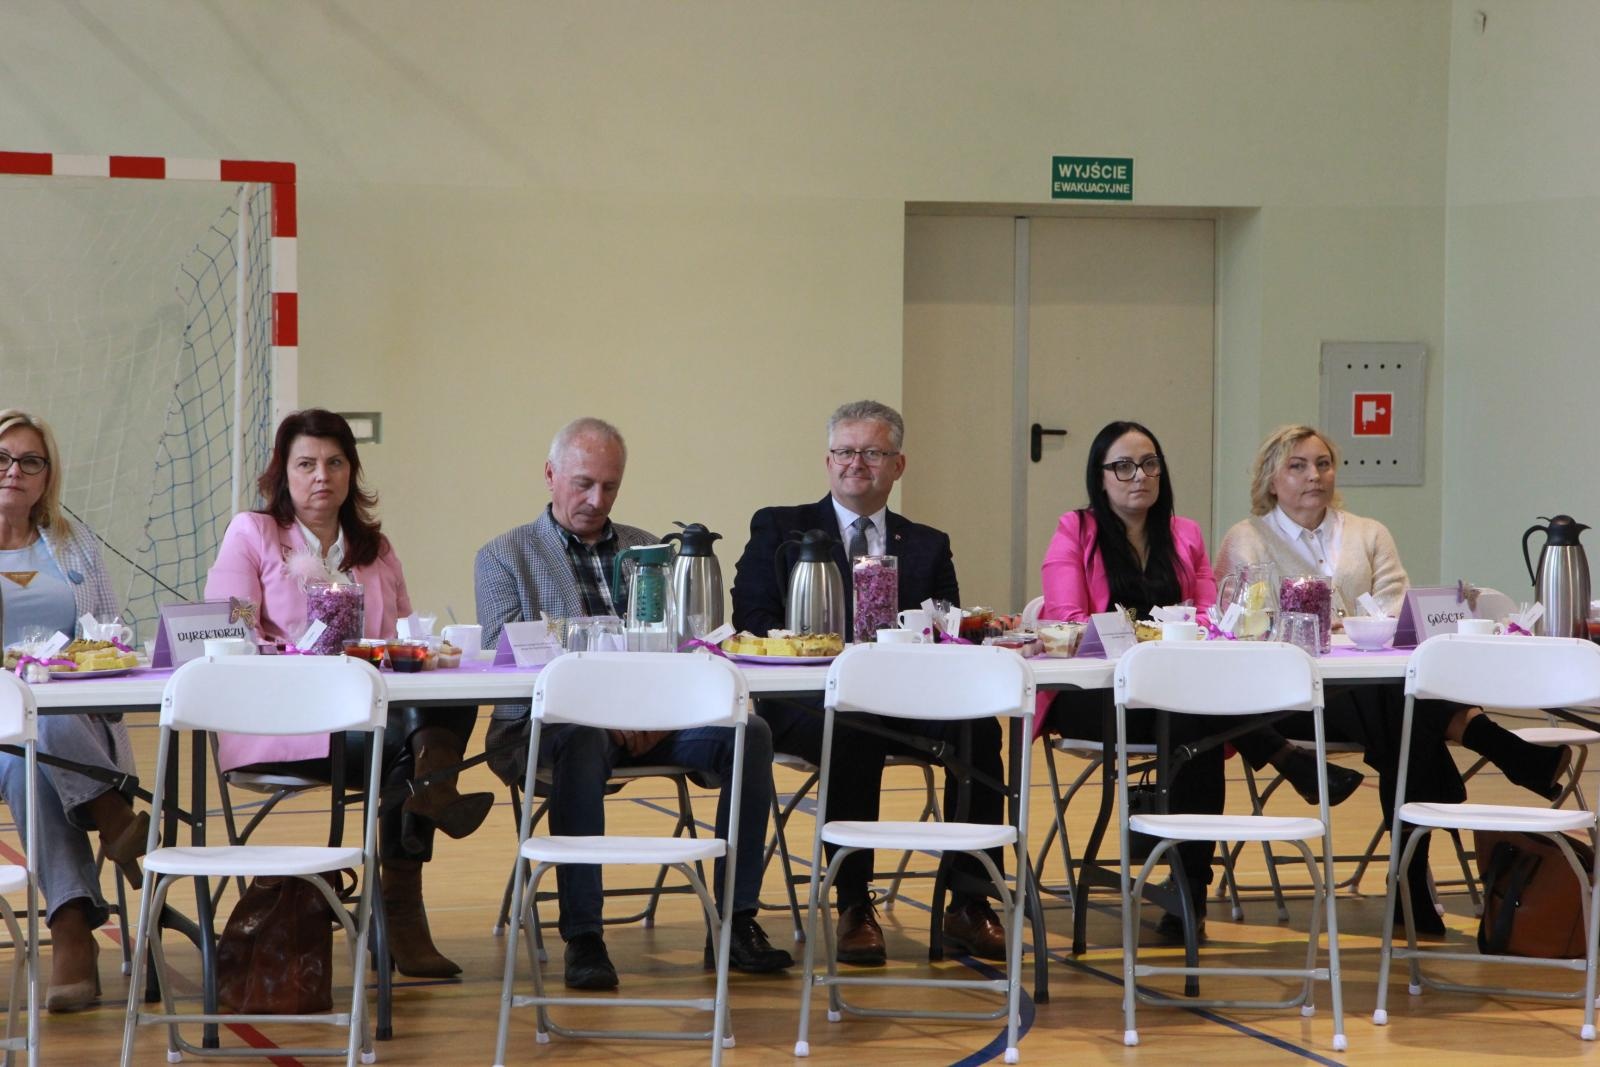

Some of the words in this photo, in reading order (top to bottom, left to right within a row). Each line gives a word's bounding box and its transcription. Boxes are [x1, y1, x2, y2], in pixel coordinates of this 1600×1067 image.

[1058, 161, 1127, 179] WYJŚCIE
[1053, 181, 1131, 194] EWAKUACYJNE
[177, 626, 246, 643] DYREKTORZY
